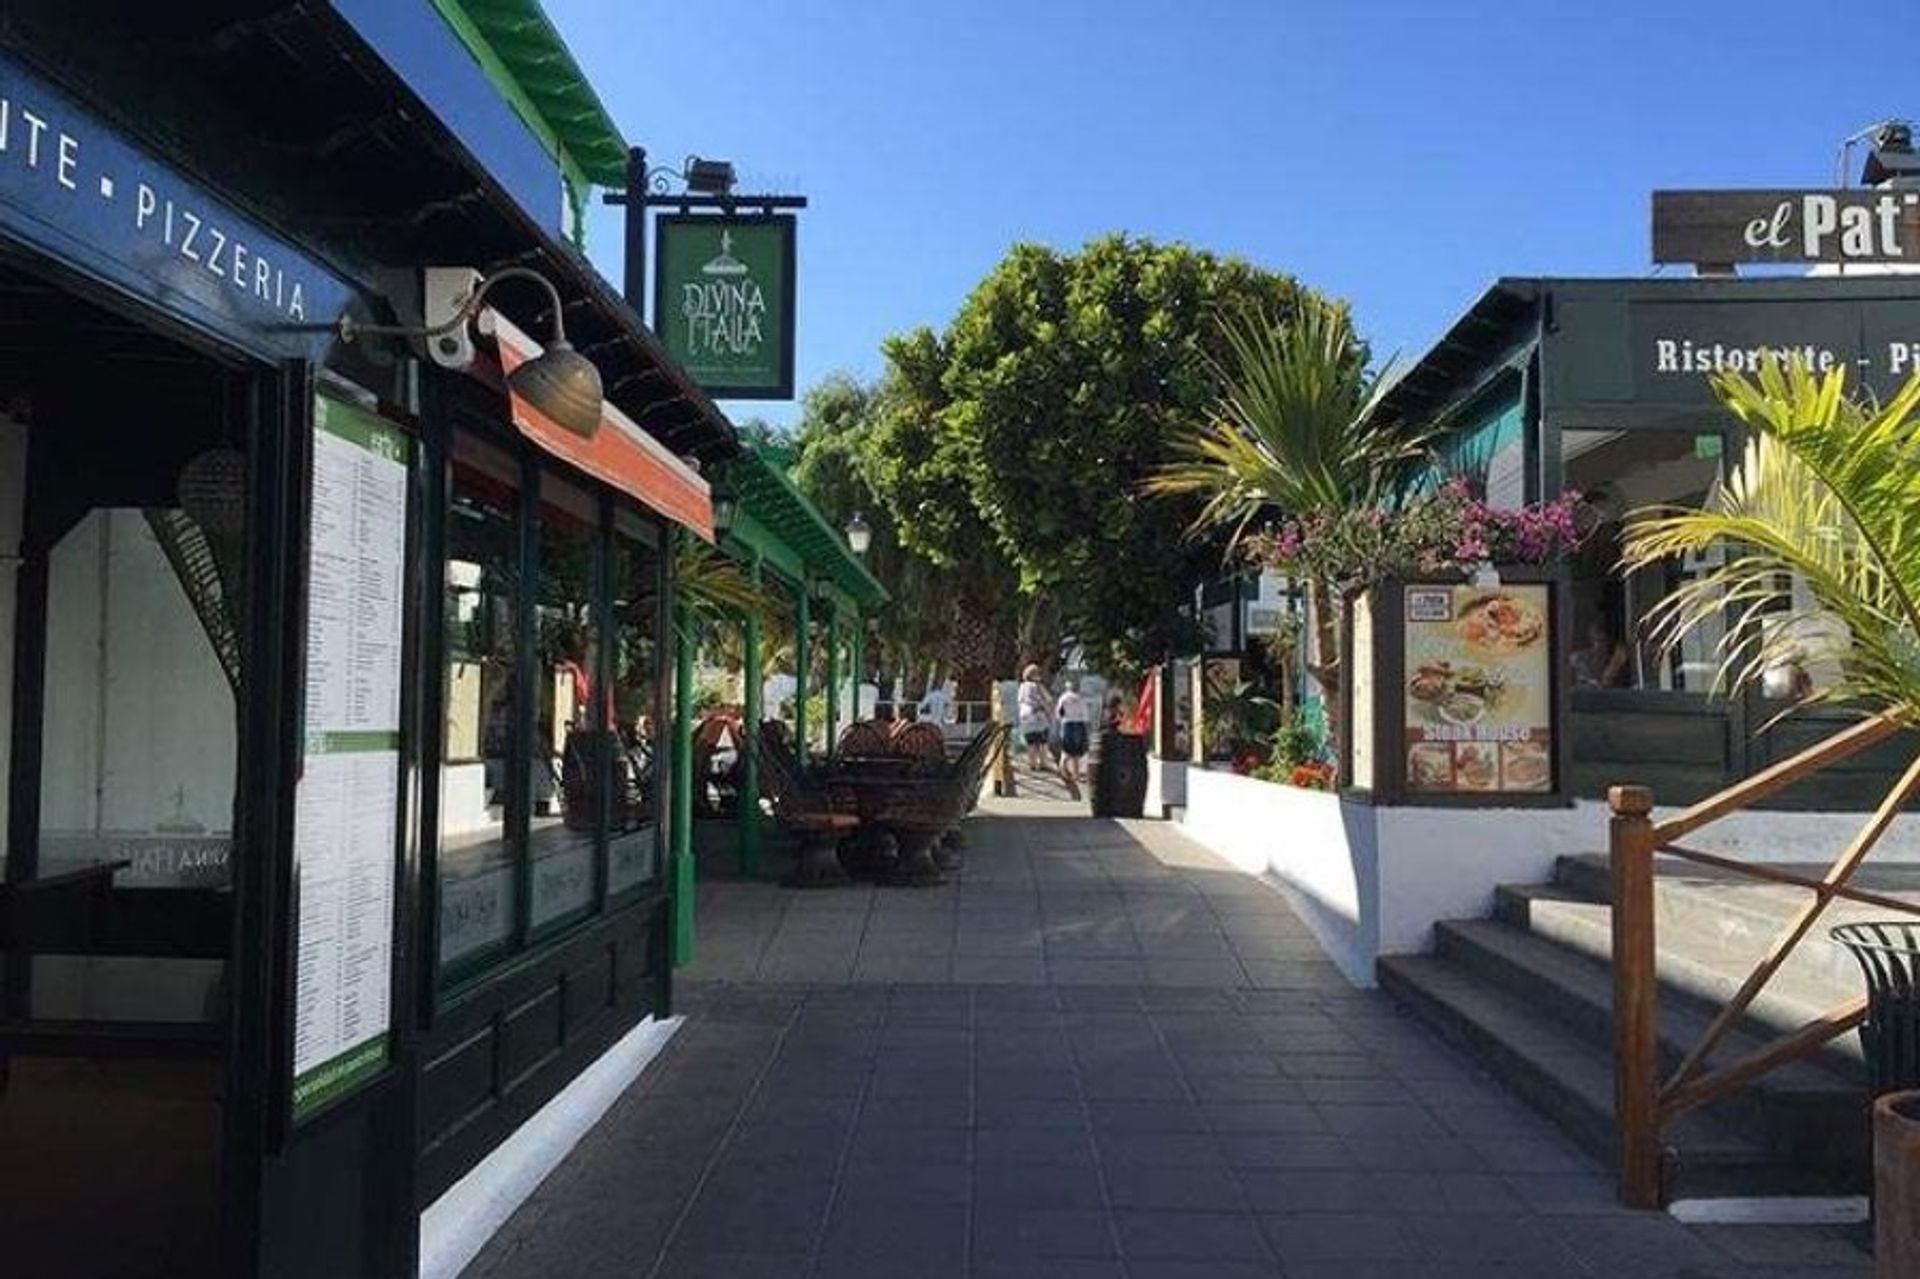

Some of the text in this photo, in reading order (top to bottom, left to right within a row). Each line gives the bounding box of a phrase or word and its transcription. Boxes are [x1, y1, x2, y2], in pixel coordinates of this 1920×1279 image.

[1744, 201, 1792, 247] el
[137, 183, 304, 321] PIZZERIA
[681, 278, 766, 318] DIVINA
